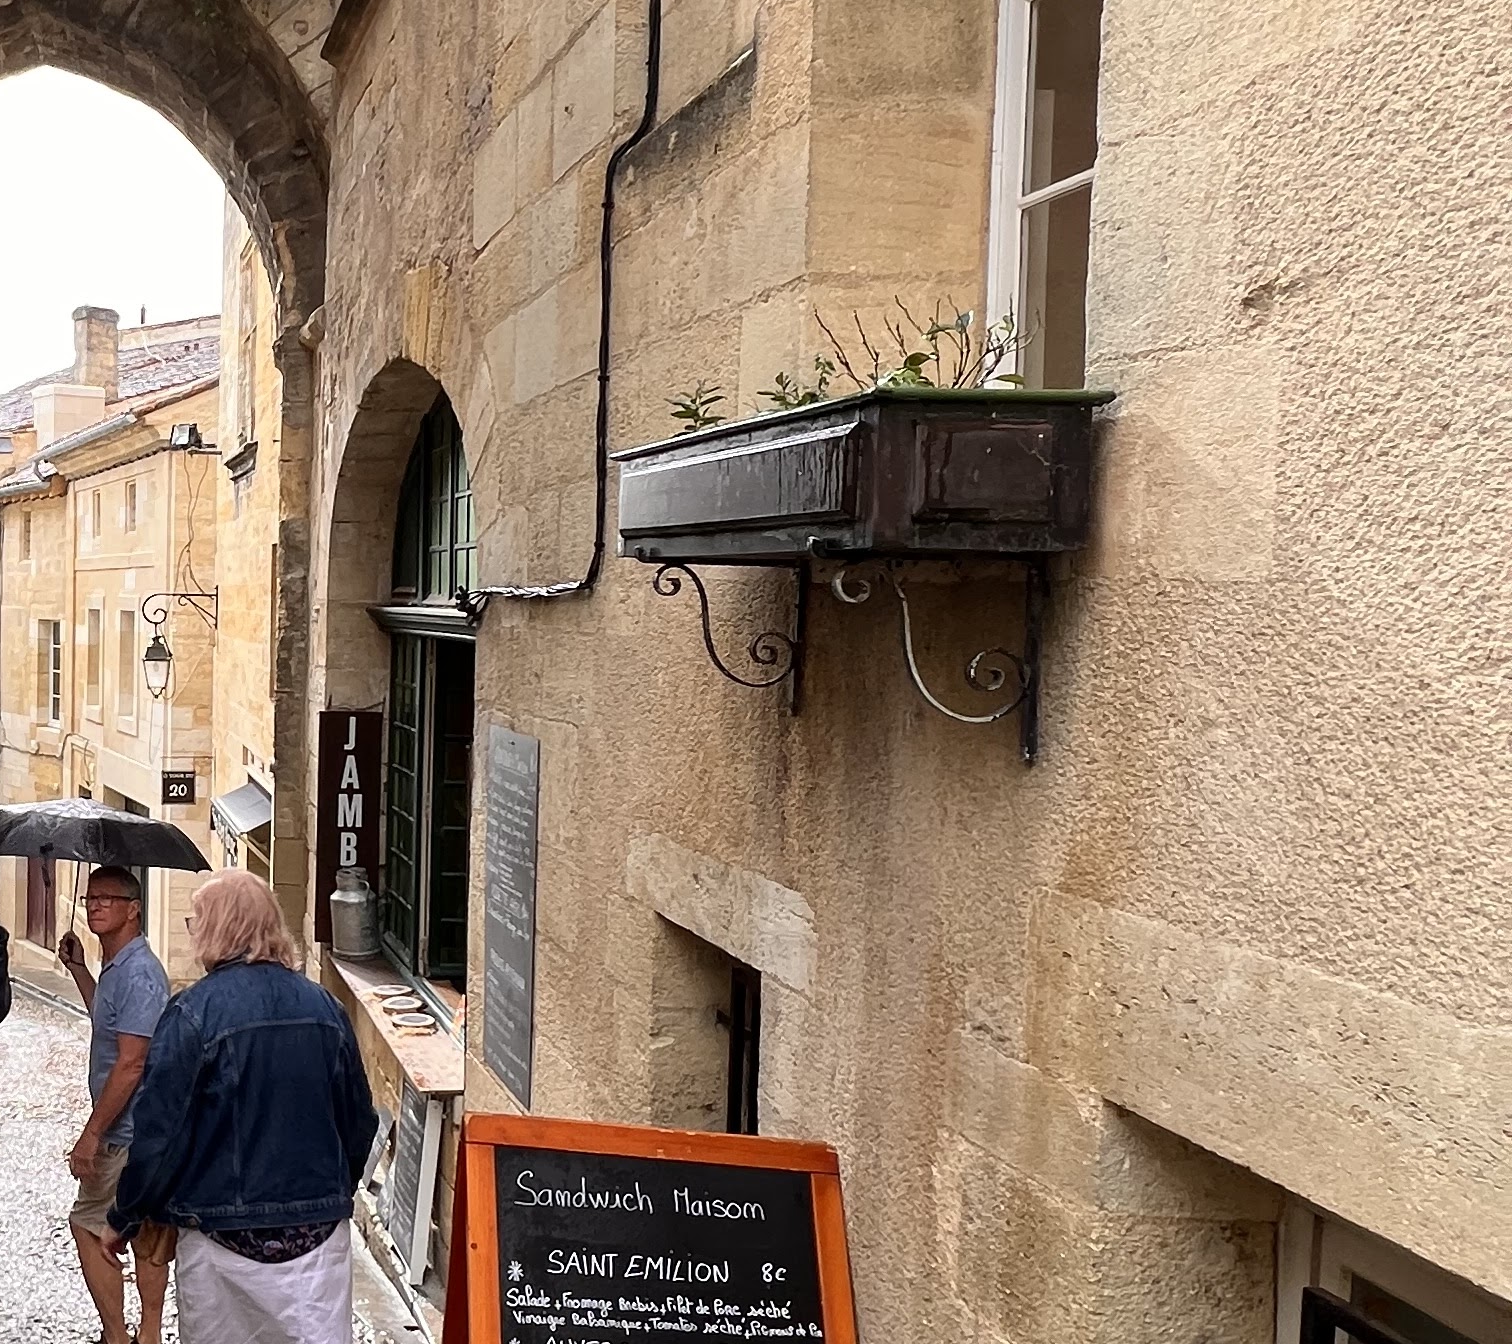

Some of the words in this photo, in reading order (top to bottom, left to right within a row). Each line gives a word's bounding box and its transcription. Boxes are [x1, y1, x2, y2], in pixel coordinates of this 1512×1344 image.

[168, 783, 188, 797] 20
[514, 1170, 654, 1215] Sandwich
[673, 1186, 766, 1221] Maison
[506, 1284, 552, 1308] Salade
[562, 1291, 613, 1318] Fromage
[695, 1298, 710, 1316] de
